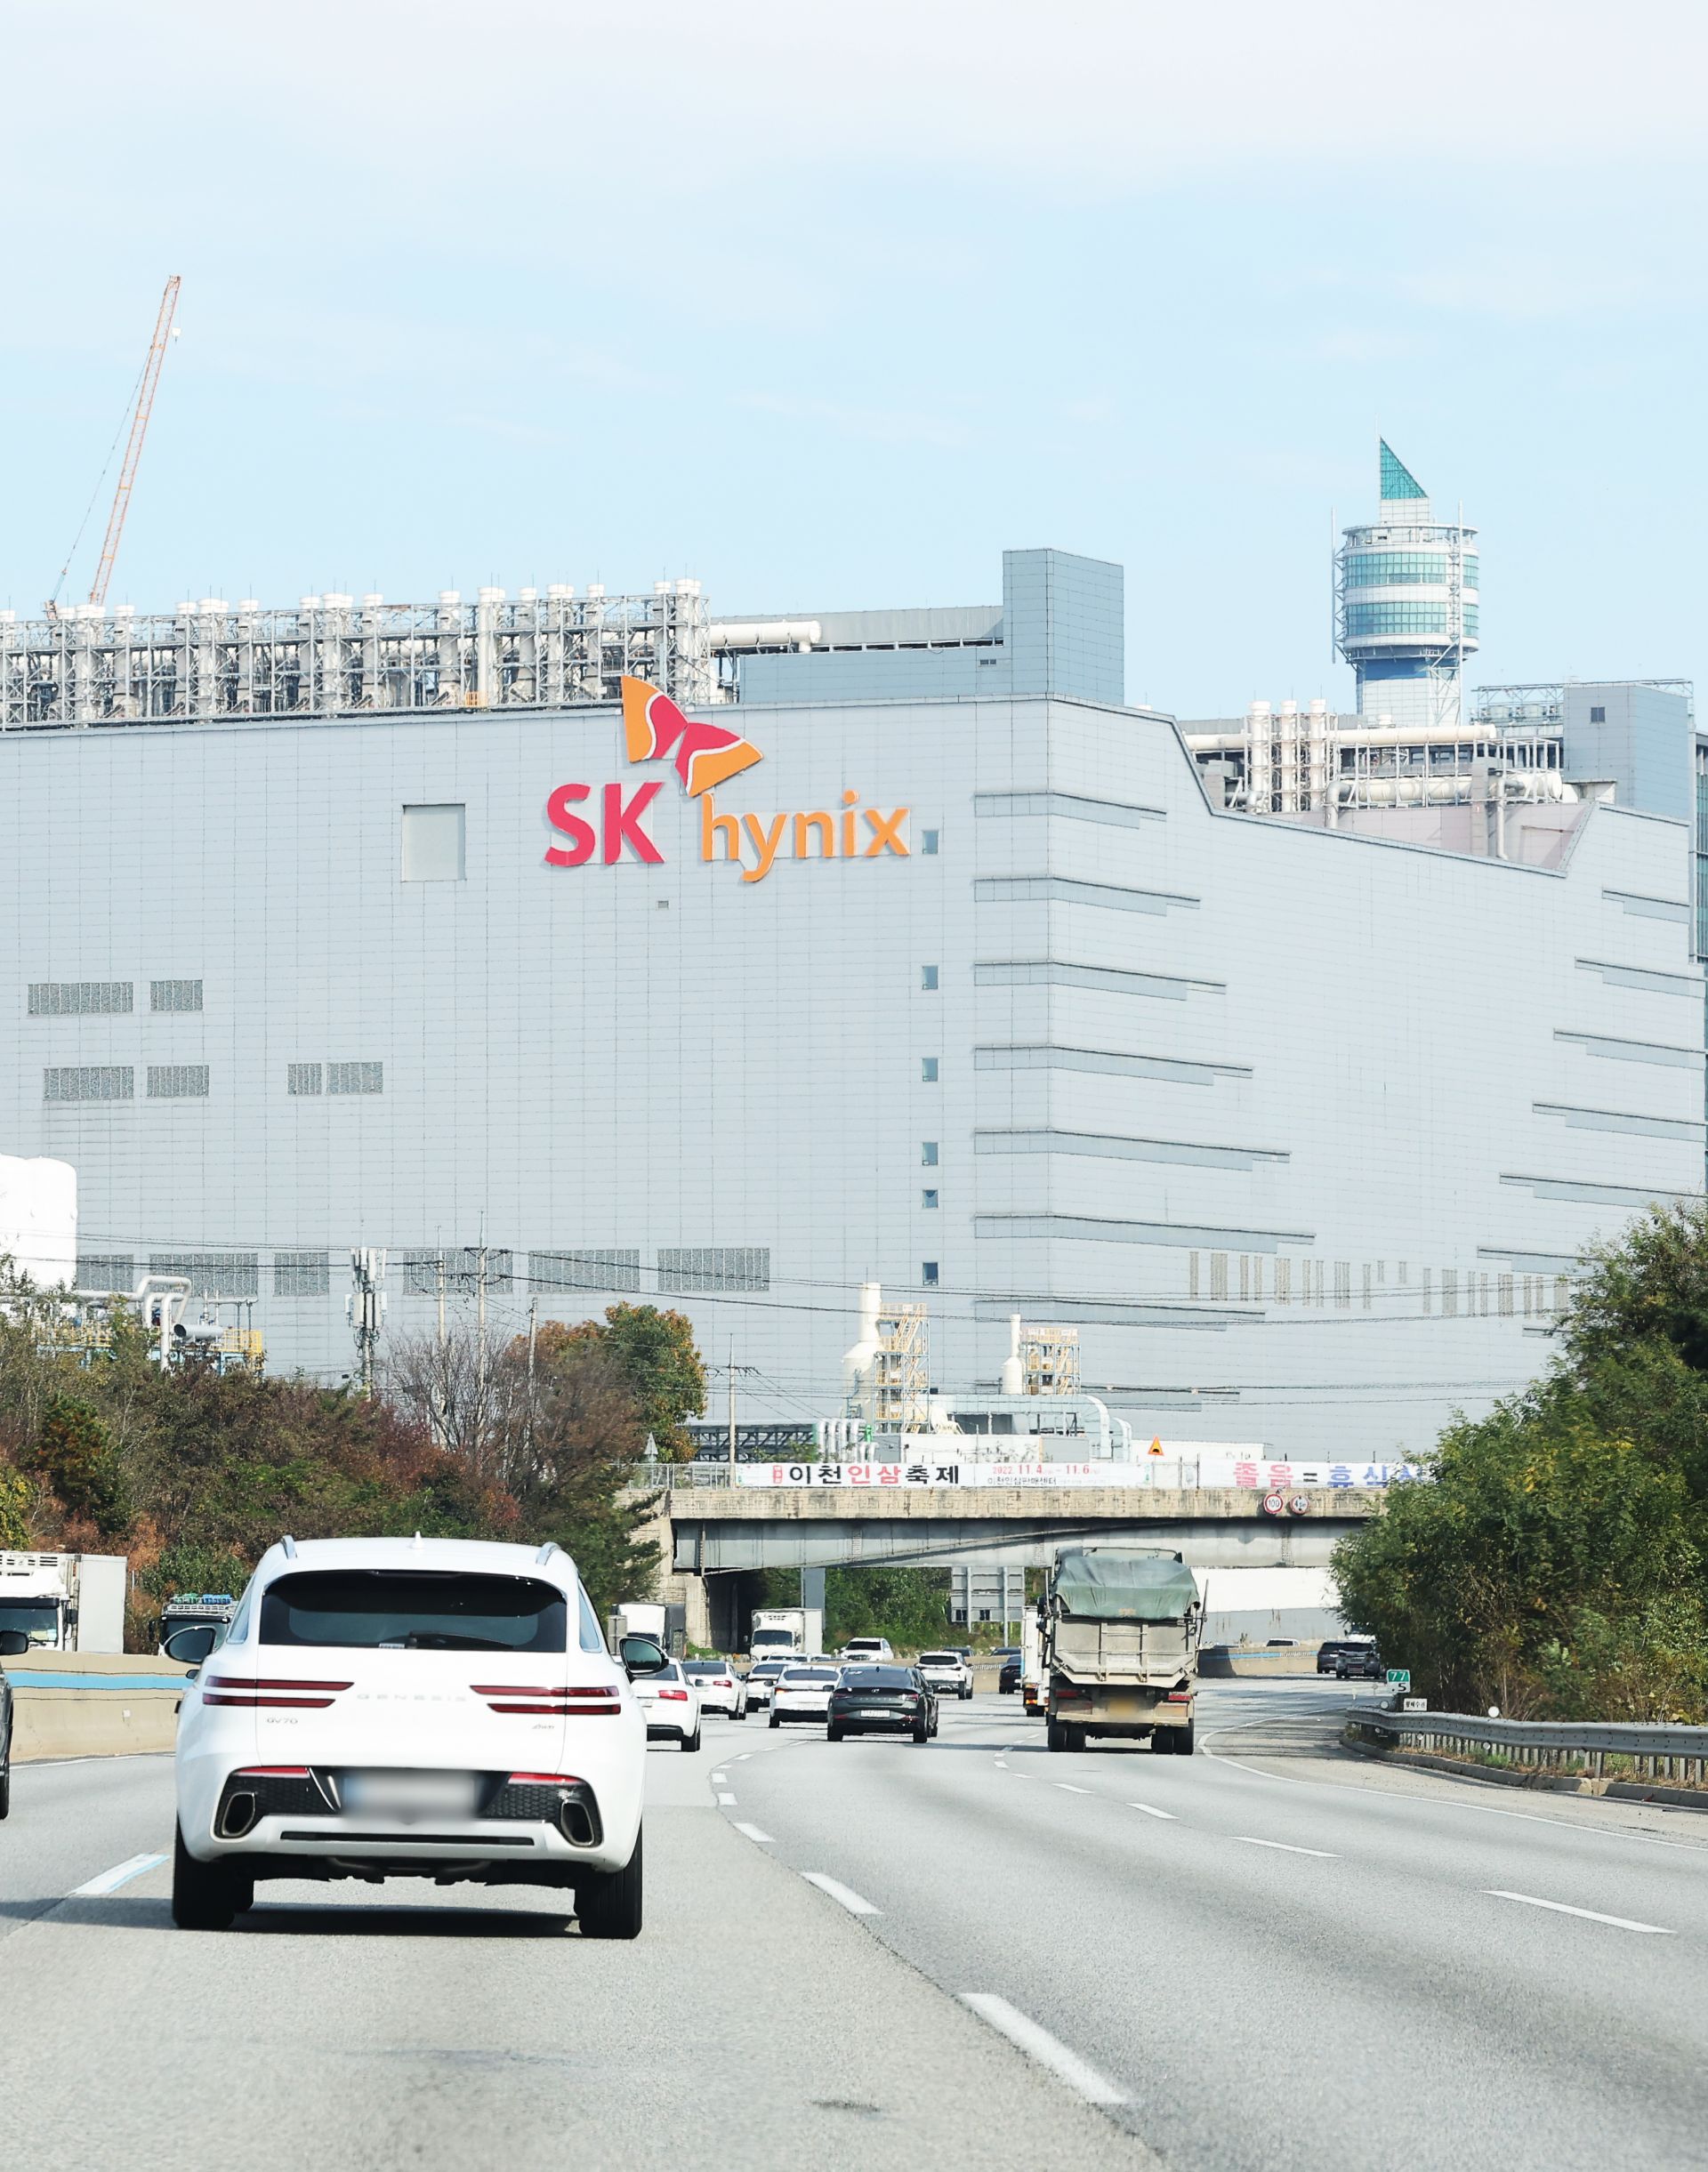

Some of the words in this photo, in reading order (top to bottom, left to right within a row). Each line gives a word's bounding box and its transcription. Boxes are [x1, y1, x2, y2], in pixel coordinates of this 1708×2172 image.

[544, 781, 665, 866] SK
[702, 789, 911, 882] hynix
[1268, 1499, 1280, 1508] 100
[1390, 1671, 1406, 1681] 77
